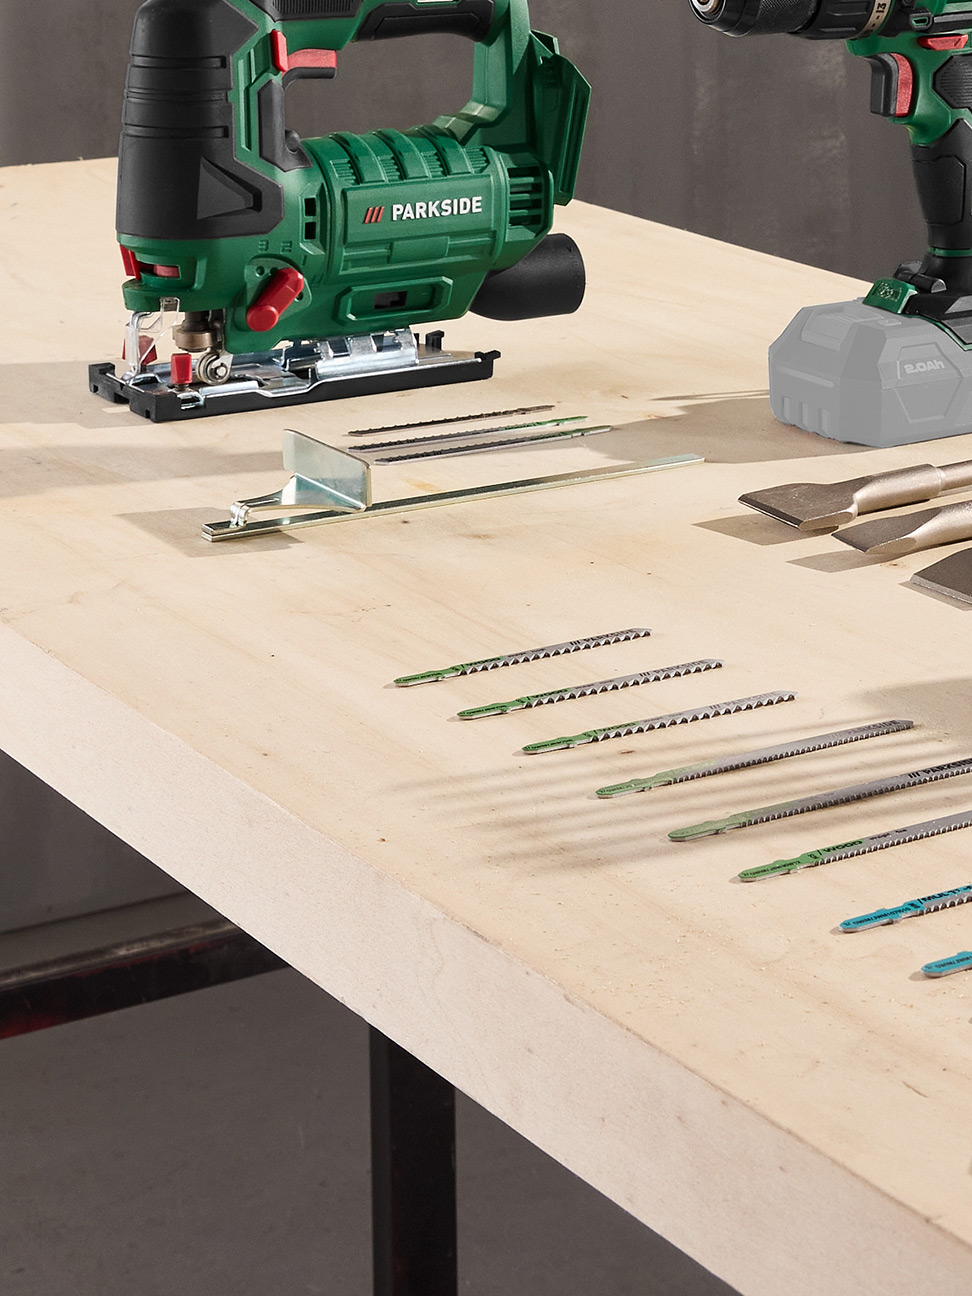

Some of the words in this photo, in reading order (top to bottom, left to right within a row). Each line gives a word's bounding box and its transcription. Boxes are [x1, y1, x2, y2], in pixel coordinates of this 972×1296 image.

[392, 196, 482, 220] PARKSIDE
[904, 359, 945, 374] 2.0Ah
[822, 839, 862, 854] WOOD
